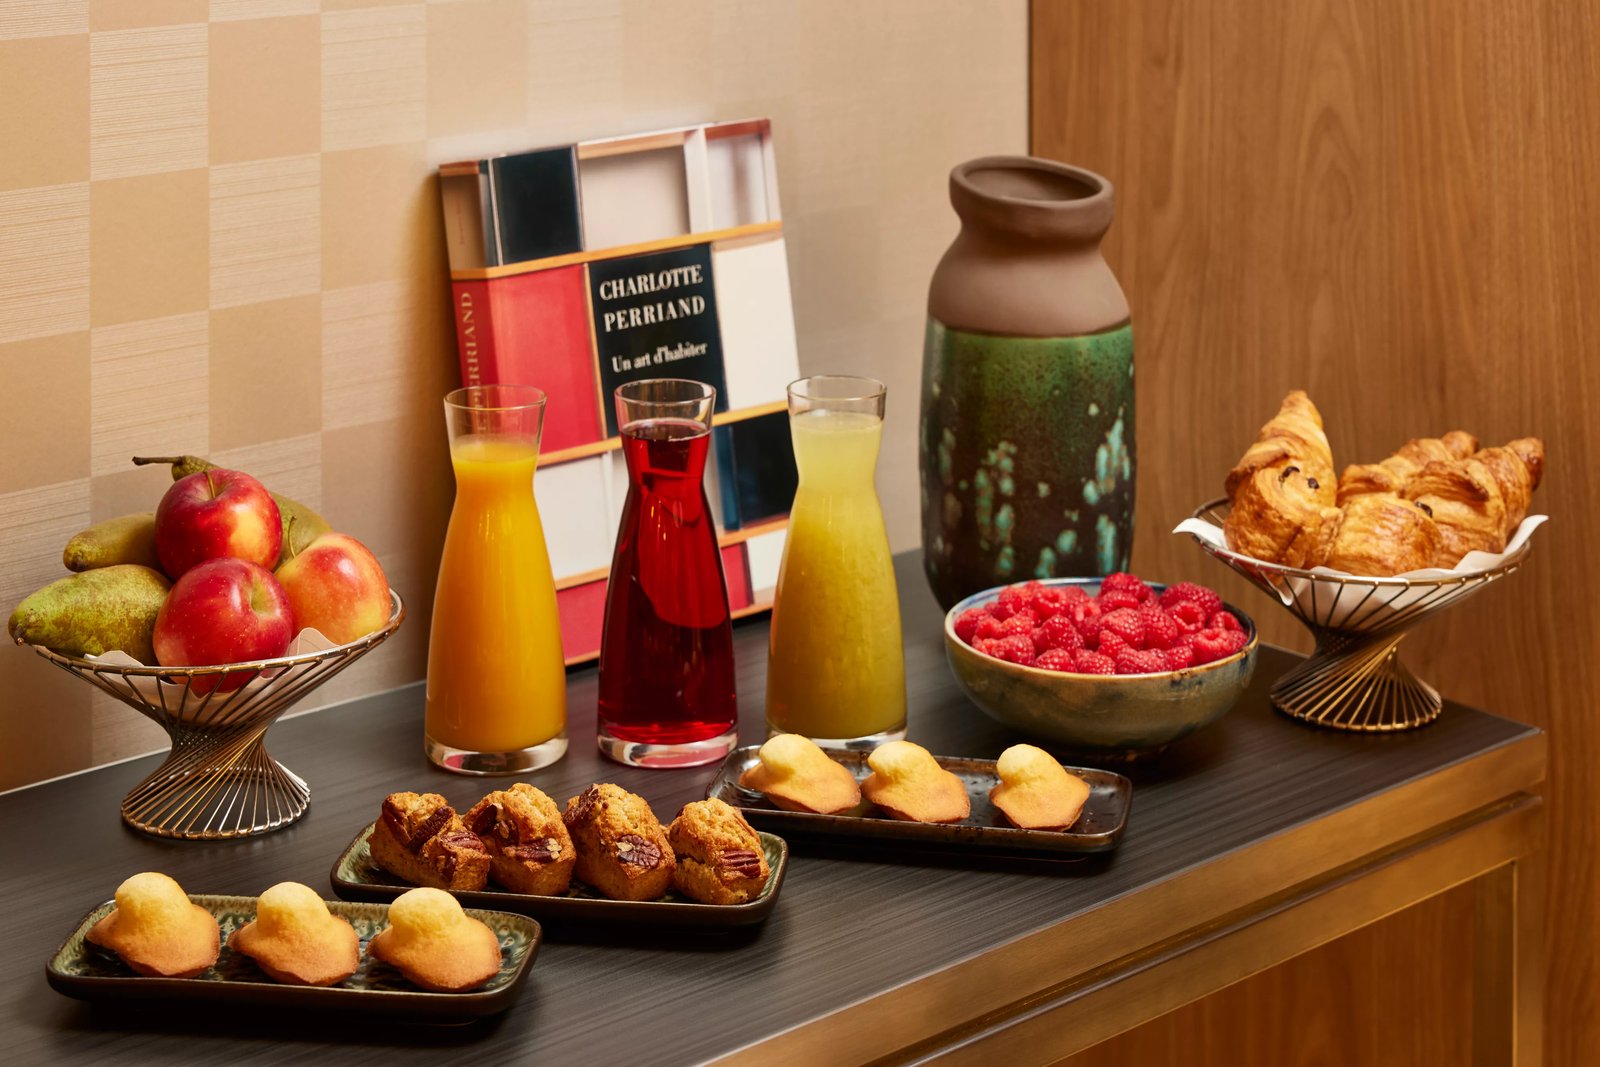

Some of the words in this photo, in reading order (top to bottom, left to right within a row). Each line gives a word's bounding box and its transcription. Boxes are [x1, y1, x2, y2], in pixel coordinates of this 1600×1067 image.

[600, 264, 703, 300] CHARLOTTE
[603, 295, 705, 332] PERRIAND
[612, 355, 631, 373] Un
[633, 352, 651, 369] art
[653, 341, 708, 364] d'habiter
